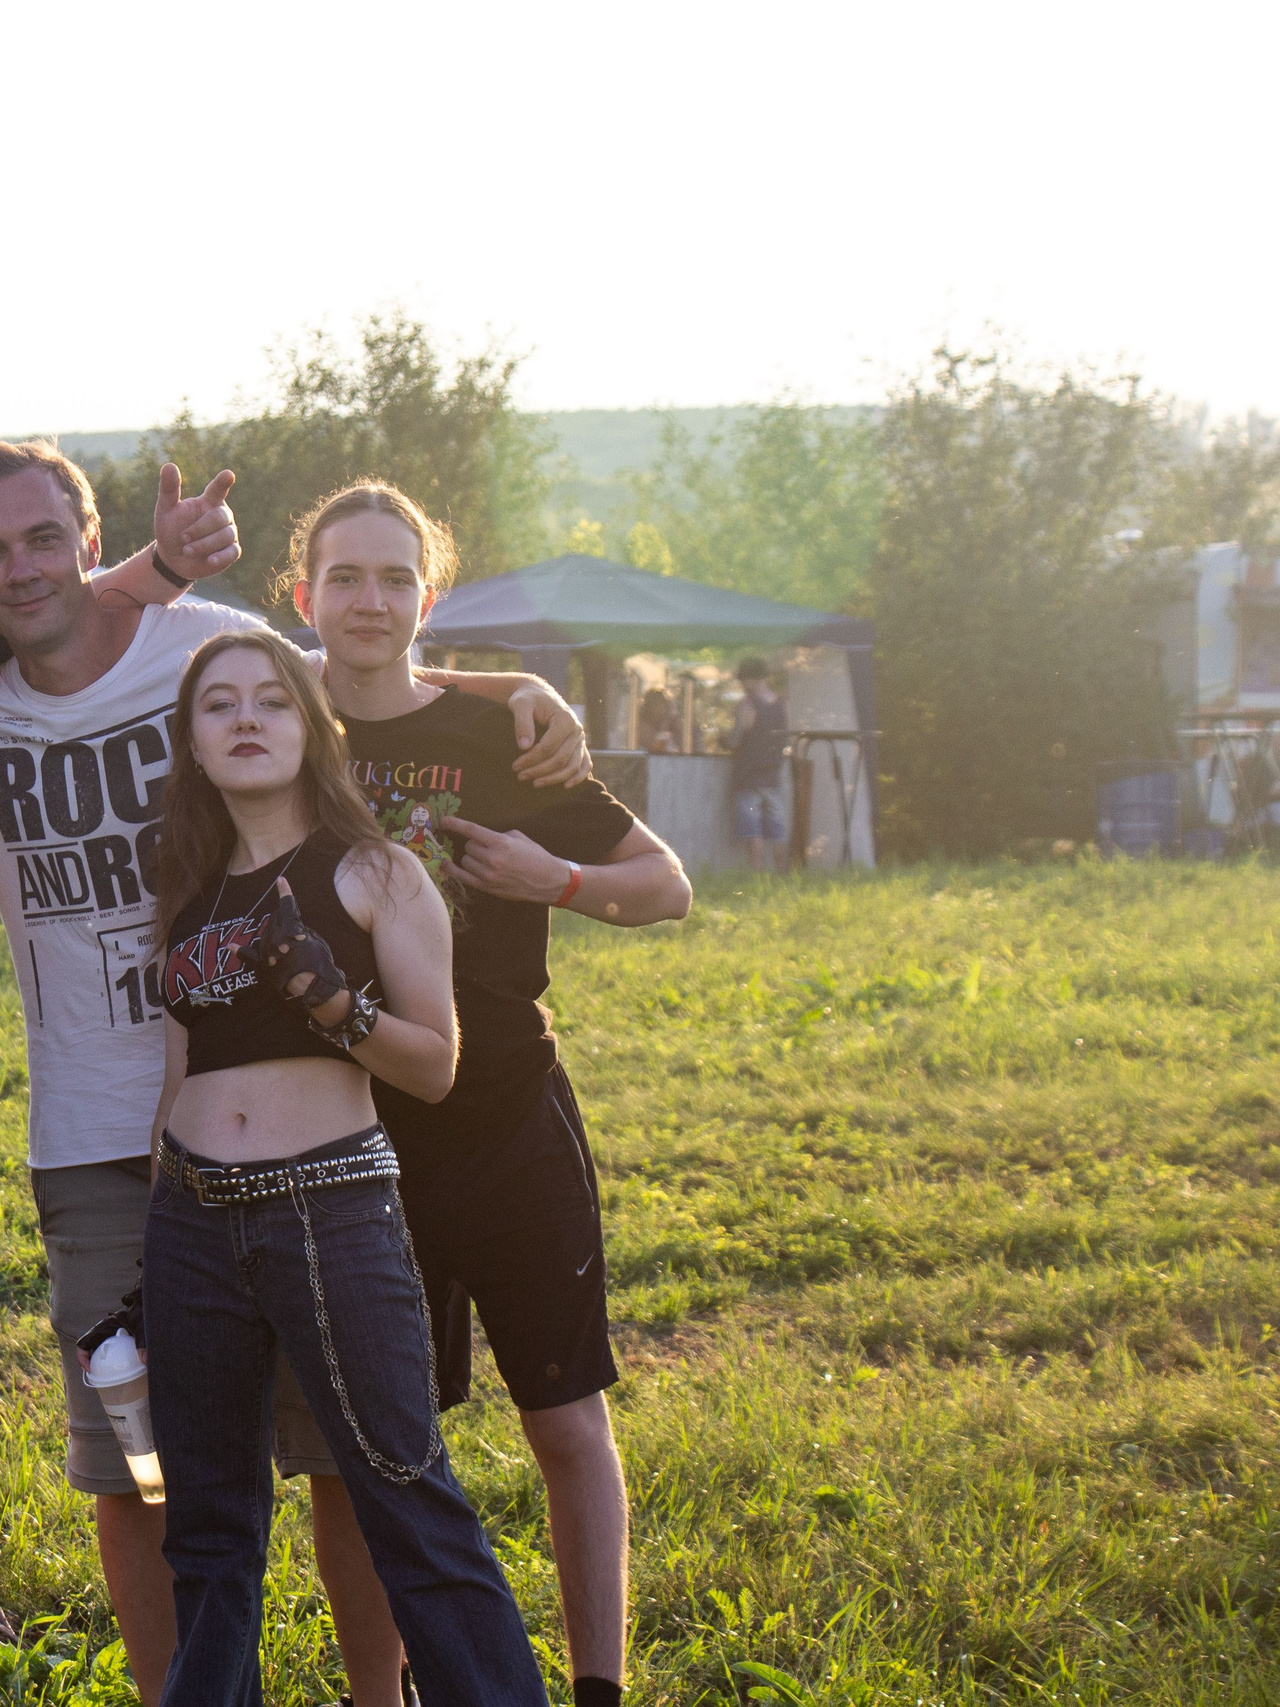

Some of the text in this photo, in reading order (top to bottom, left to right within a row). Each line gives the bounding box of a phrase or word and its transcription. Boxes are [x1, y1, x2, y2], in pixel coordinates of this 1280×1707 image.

[348, 761, 462, 792] UGGAH
[17, 851, 90, 910] AND
[99, 911, 115, 919] BEST
[119, 905, 141, 915] SONGS
[137, 933, 157, 947] ROC
[118, 953, 136, 961] HARD
[212, 970, 258, 997] PLEASE
